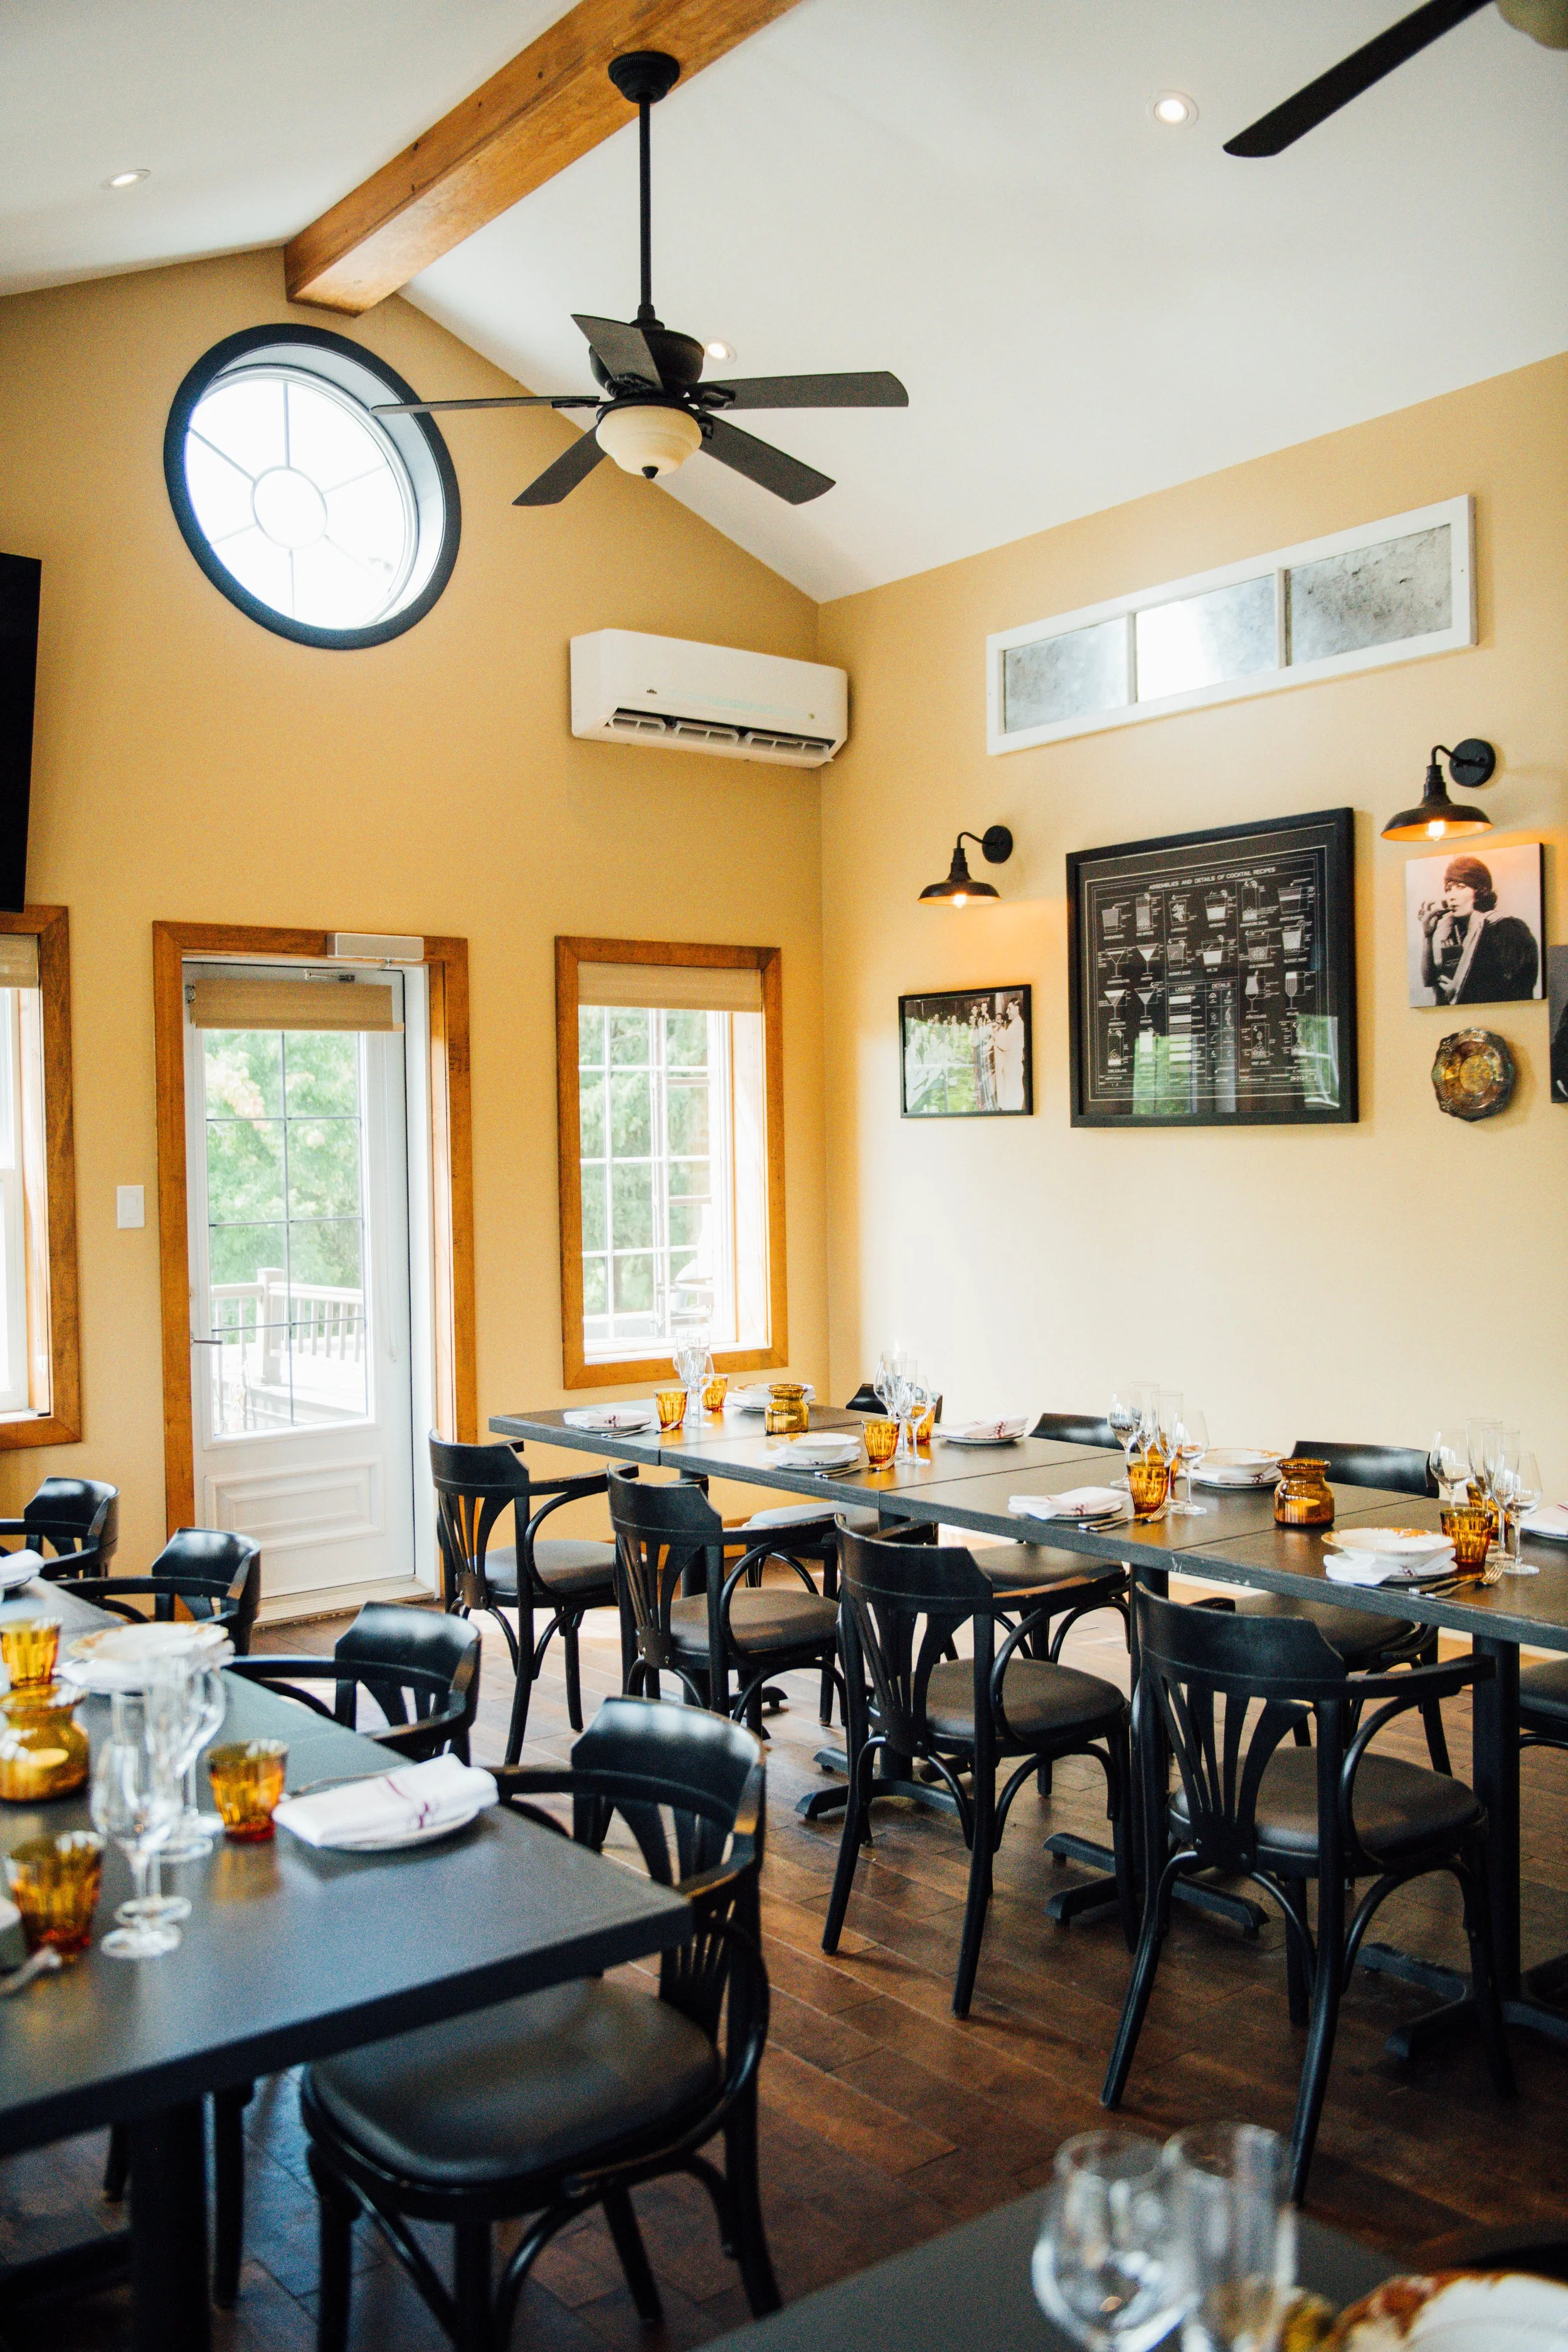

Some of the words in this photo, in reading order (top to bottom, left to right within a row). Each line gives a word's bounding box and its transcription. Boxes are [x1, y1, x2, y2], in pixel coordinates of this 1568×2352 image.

[1149, 881, 1179, 889] ASSEMBLIES
[1226, 871, 1252, 879] COCKTAIL
[1253, 867, 1276, 875] RECIPES
